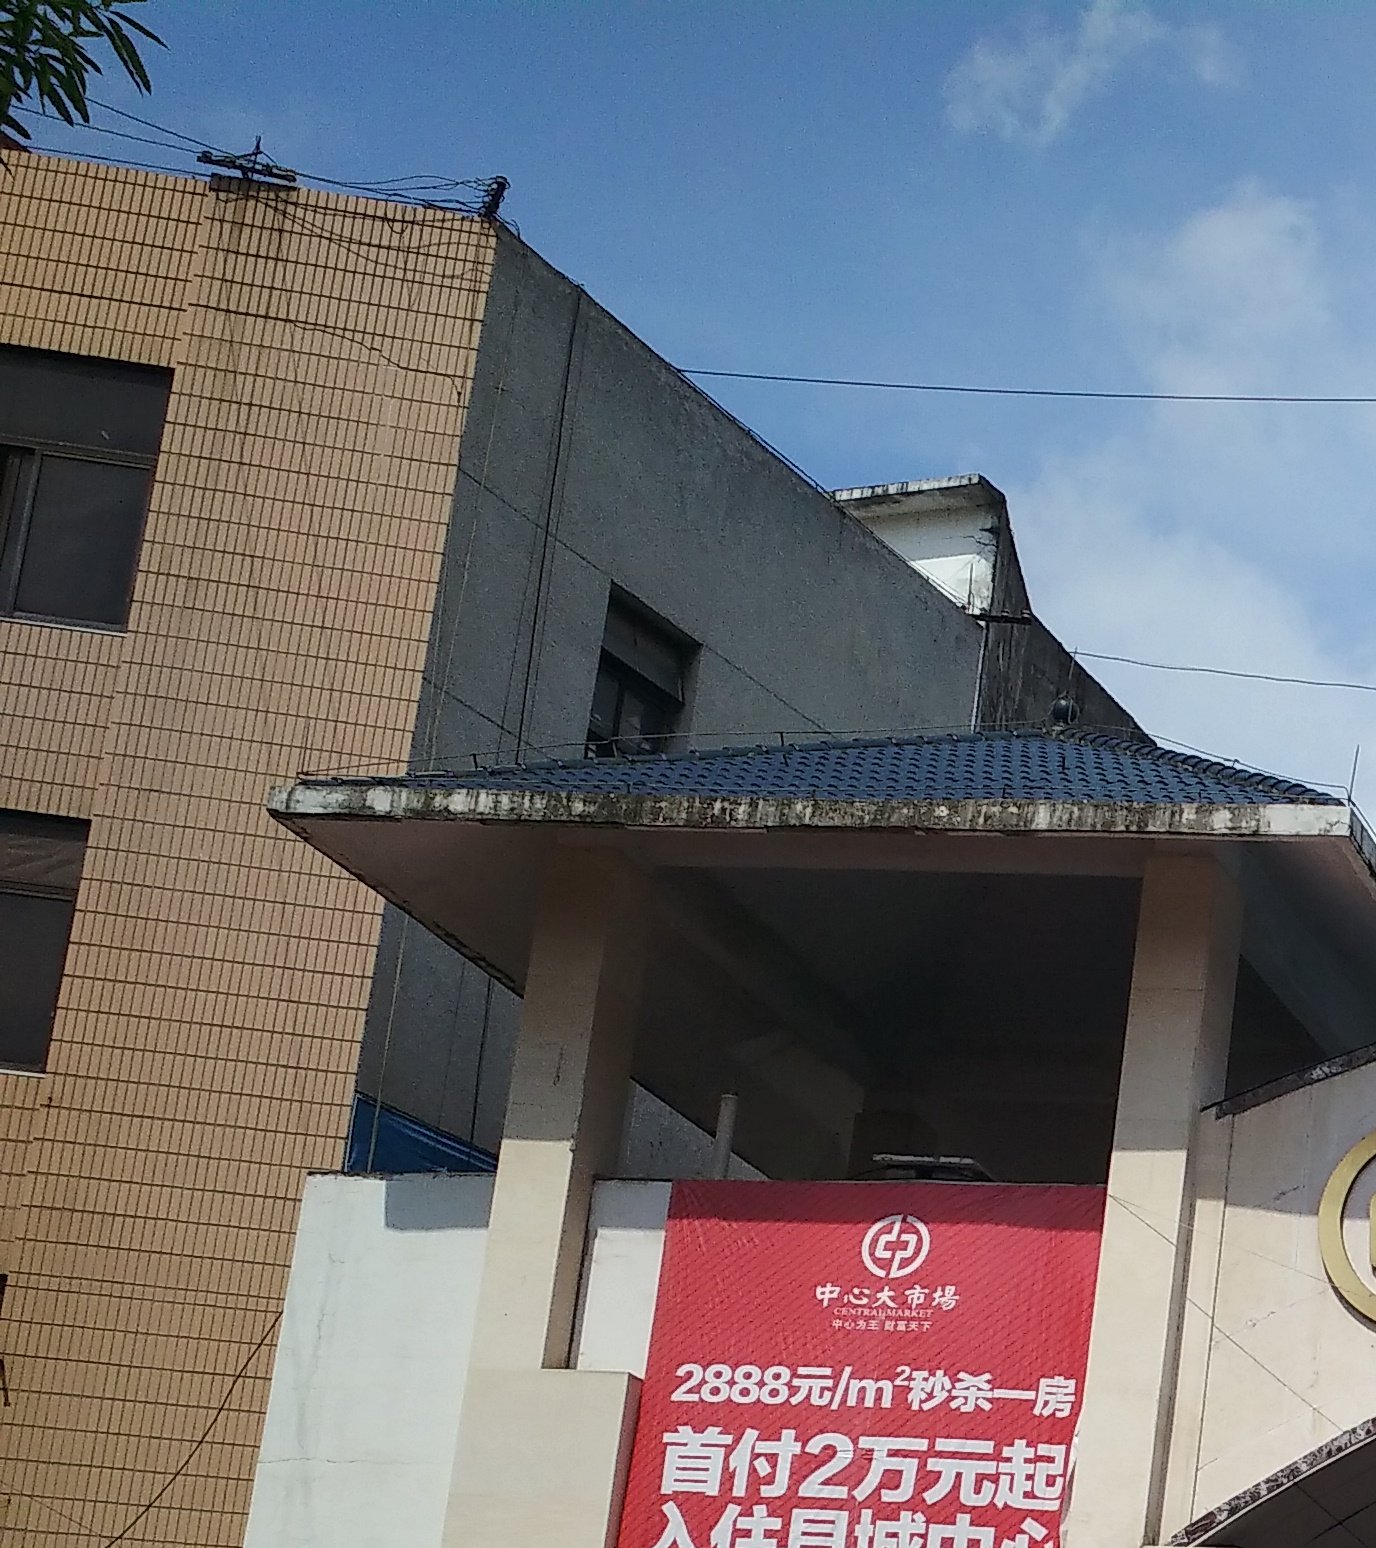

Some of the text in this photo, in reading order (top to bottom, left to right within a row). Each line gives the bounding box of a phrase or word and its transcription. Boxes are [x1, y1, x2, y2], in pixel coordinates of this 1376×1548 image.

[816, 1283, 959, 1311] 中心大市場
[834, 1307, 934, 1318] CENTRAL MARKET
[832, 1319, 933, 1332] 中心为王 财富天下
[659, 1426, 1070, 1512] 首付2万元起
